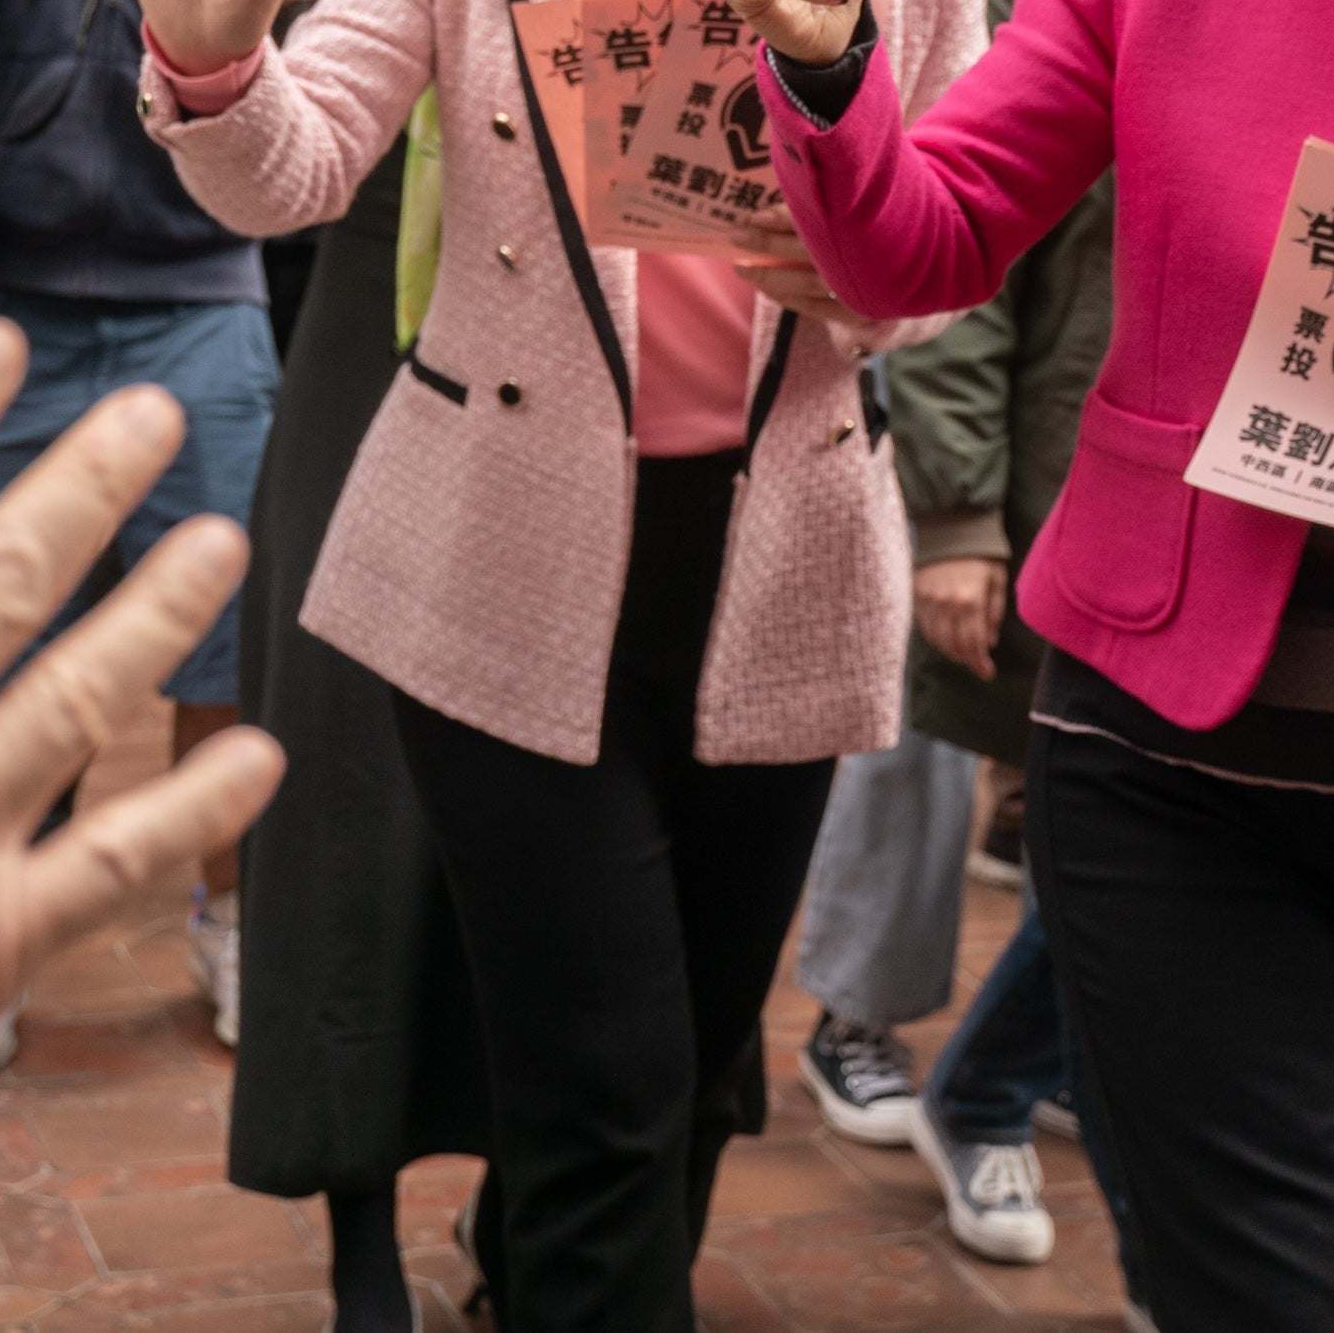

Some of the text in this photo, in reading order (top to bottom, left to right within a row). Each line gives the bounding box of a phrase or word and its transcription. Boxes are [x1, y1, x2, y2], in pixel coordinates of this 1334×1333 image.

[606, 22, 674, 71] 告
[700, 0, 764, 47] 告
[647, 153, 786, 213] 葉劉淑
[1280, 306, 1330, 381] 票投
